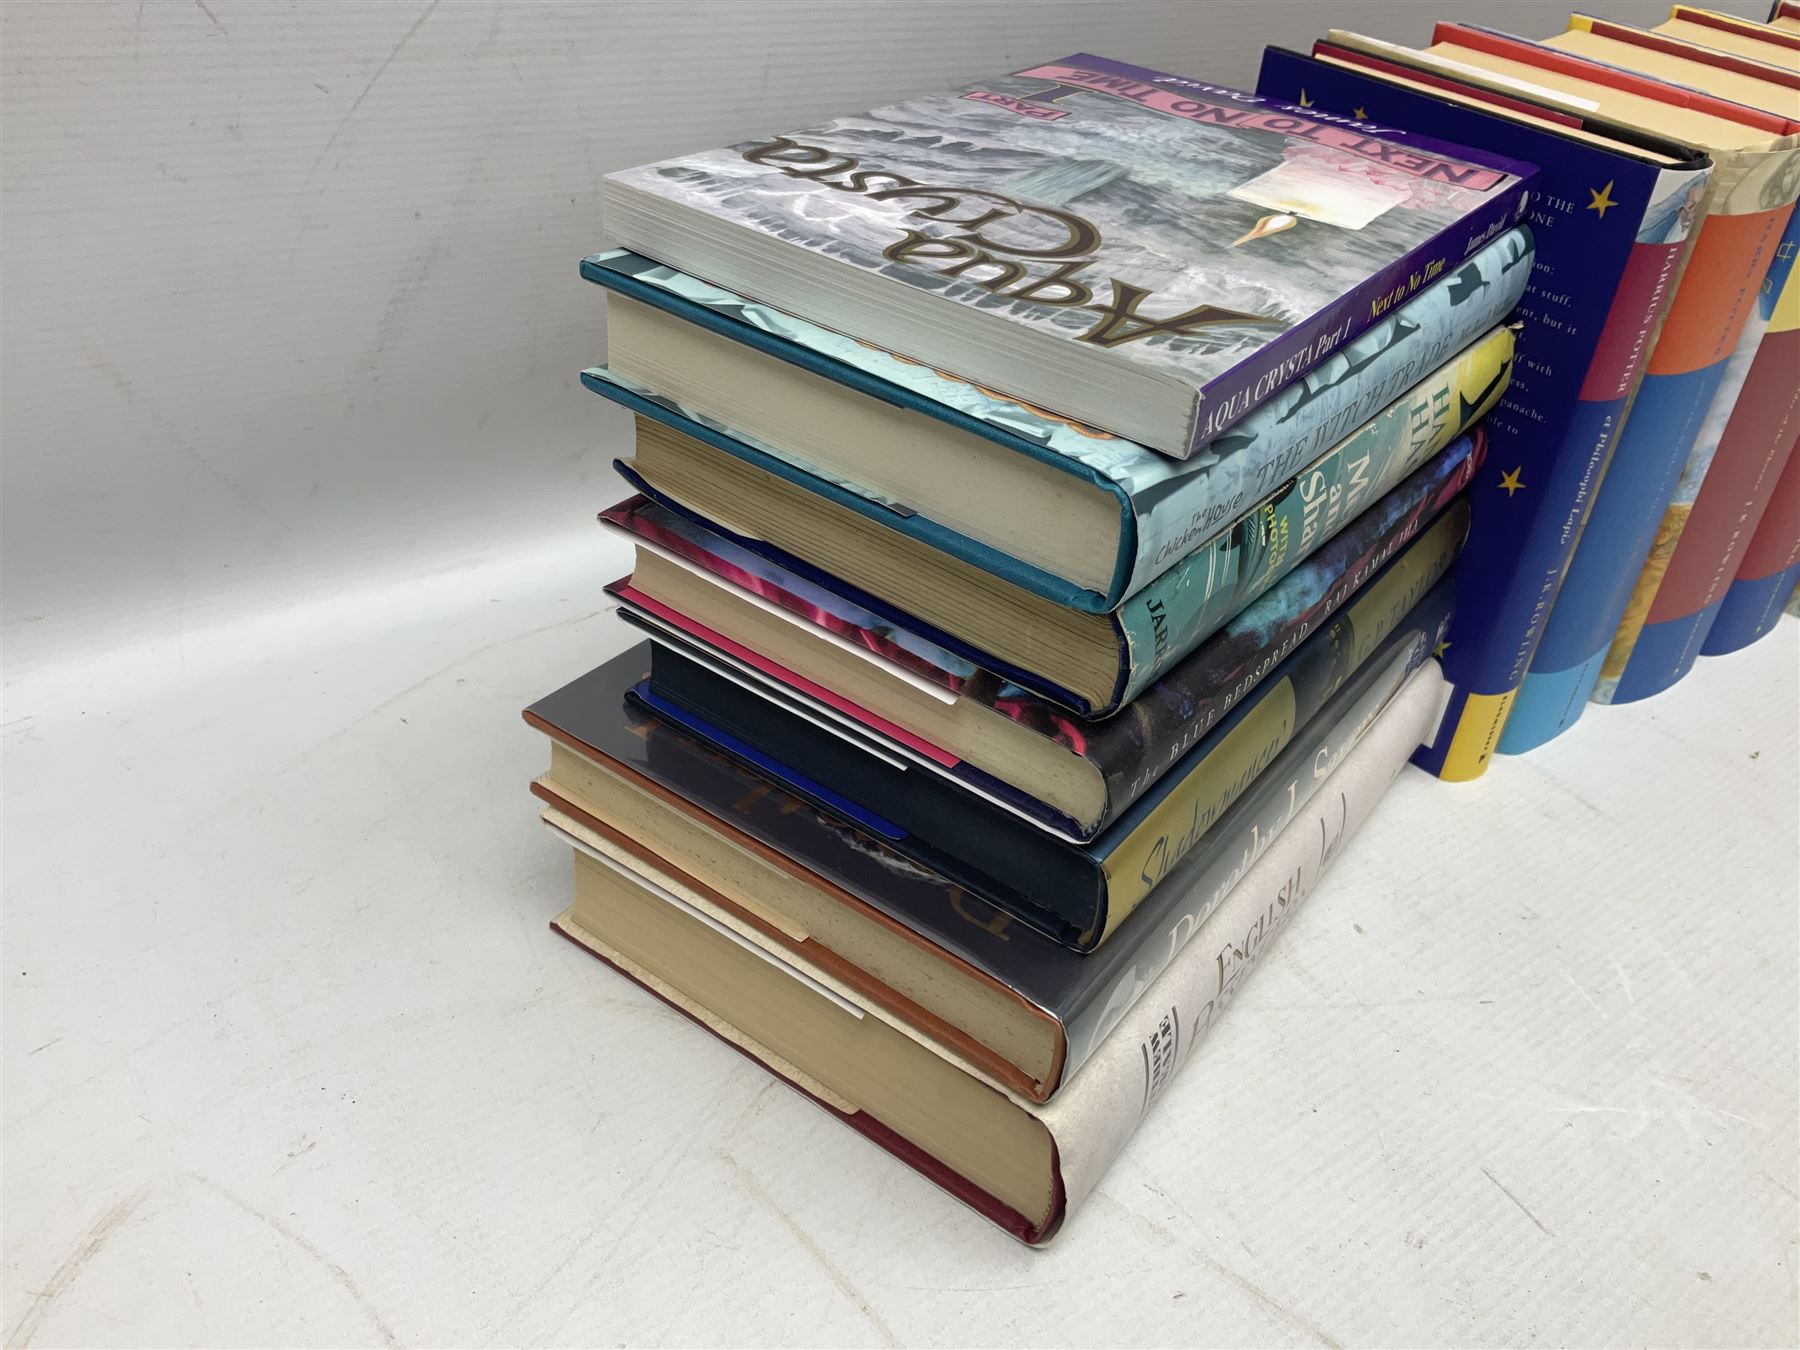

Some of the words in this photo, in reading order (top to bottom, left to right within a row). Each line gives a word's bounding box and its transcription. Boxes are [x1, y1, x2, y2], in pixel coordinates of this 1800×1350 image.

[1056, 71, 1162, 102] TIME
[969, 92, 1057, 118] PART
[1170, 100, 1247, 127] NO
[1263, 117, 1327, 141] TO
[1340, 139, 1479, 185] NEXT
[1547, 195, 1575, 214] THE
[882, 228, 1284, 348] Aqua
[1367, 290, 1394, 323] Next
[1392, 284, 1406, 302] to
[1404, 271, 1422, 294] No
[1420, 255, 1447, 284] Time
[1541, 289, 1572, 308] stuff.
[1644, 247, 1678, 324] HARRIUS
[1543, 313, 1563, 330] but
[1567, 324, 1577, 335] it
[1527, 360, 1553, 377] with
[1616, 329, 1647, 393] POTTER
[1202, 381, 1251, 439] AQUA
[1253, 341, 1318, 401] CRYSTA
[1313, 327, 1343, 362] Part
[1256, 435, 1310, 496] THE
[1312, 377, 1387, 451] WITCH
[1388, 333, 1454, 400] TRADE
[1500, 398, 1547, 424] panache.
[1603, 414, 1613, 428] et
[1507, 424, 1519, 435] to
[1575, 432, 1608, 504] Philosophi
[1559, 508, 1580, 545] Lapis
[1130, 764, 1160, 799] The
[1169, 708, 1216, 761] BLUE
[1222, 621, 1310, 711] BEDSPREAD
[1215, 865, 1304, 998] ENGLISH
